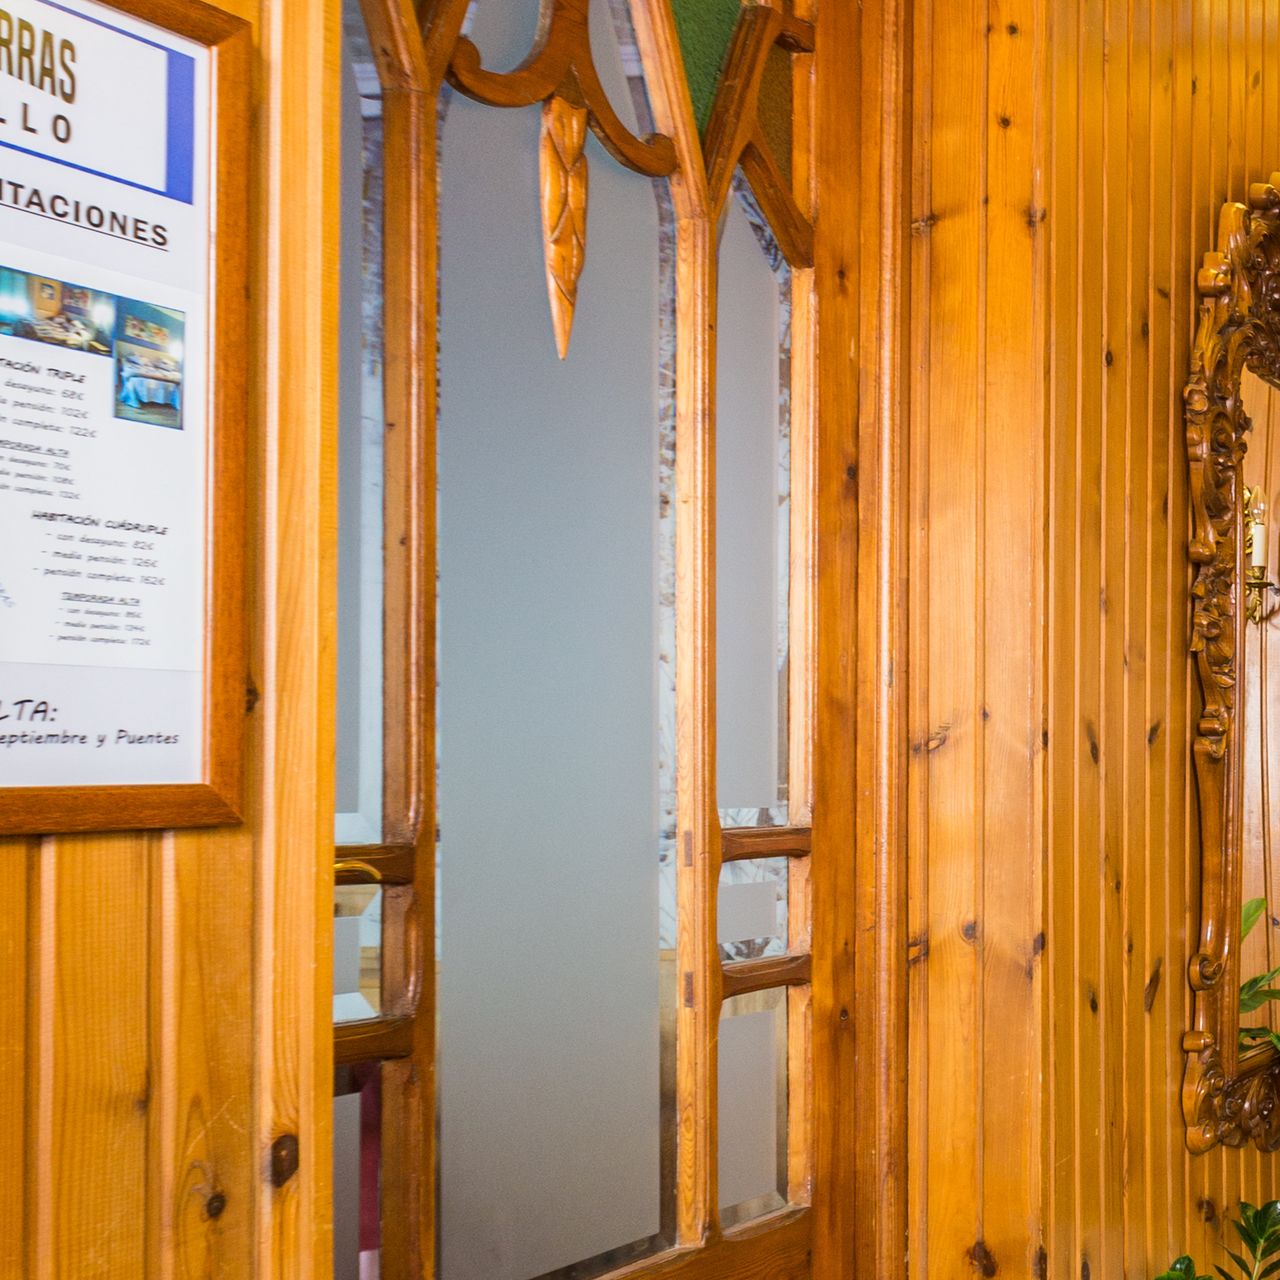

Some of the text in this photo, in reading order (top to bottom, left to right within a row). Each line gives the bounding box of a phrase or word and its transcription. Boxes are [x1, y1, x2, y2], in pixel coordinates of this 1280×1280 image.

[0, 102, 71, 143] LO
[96, 733, 107, 748] y
[114, 728, 180, 744] Puentes
